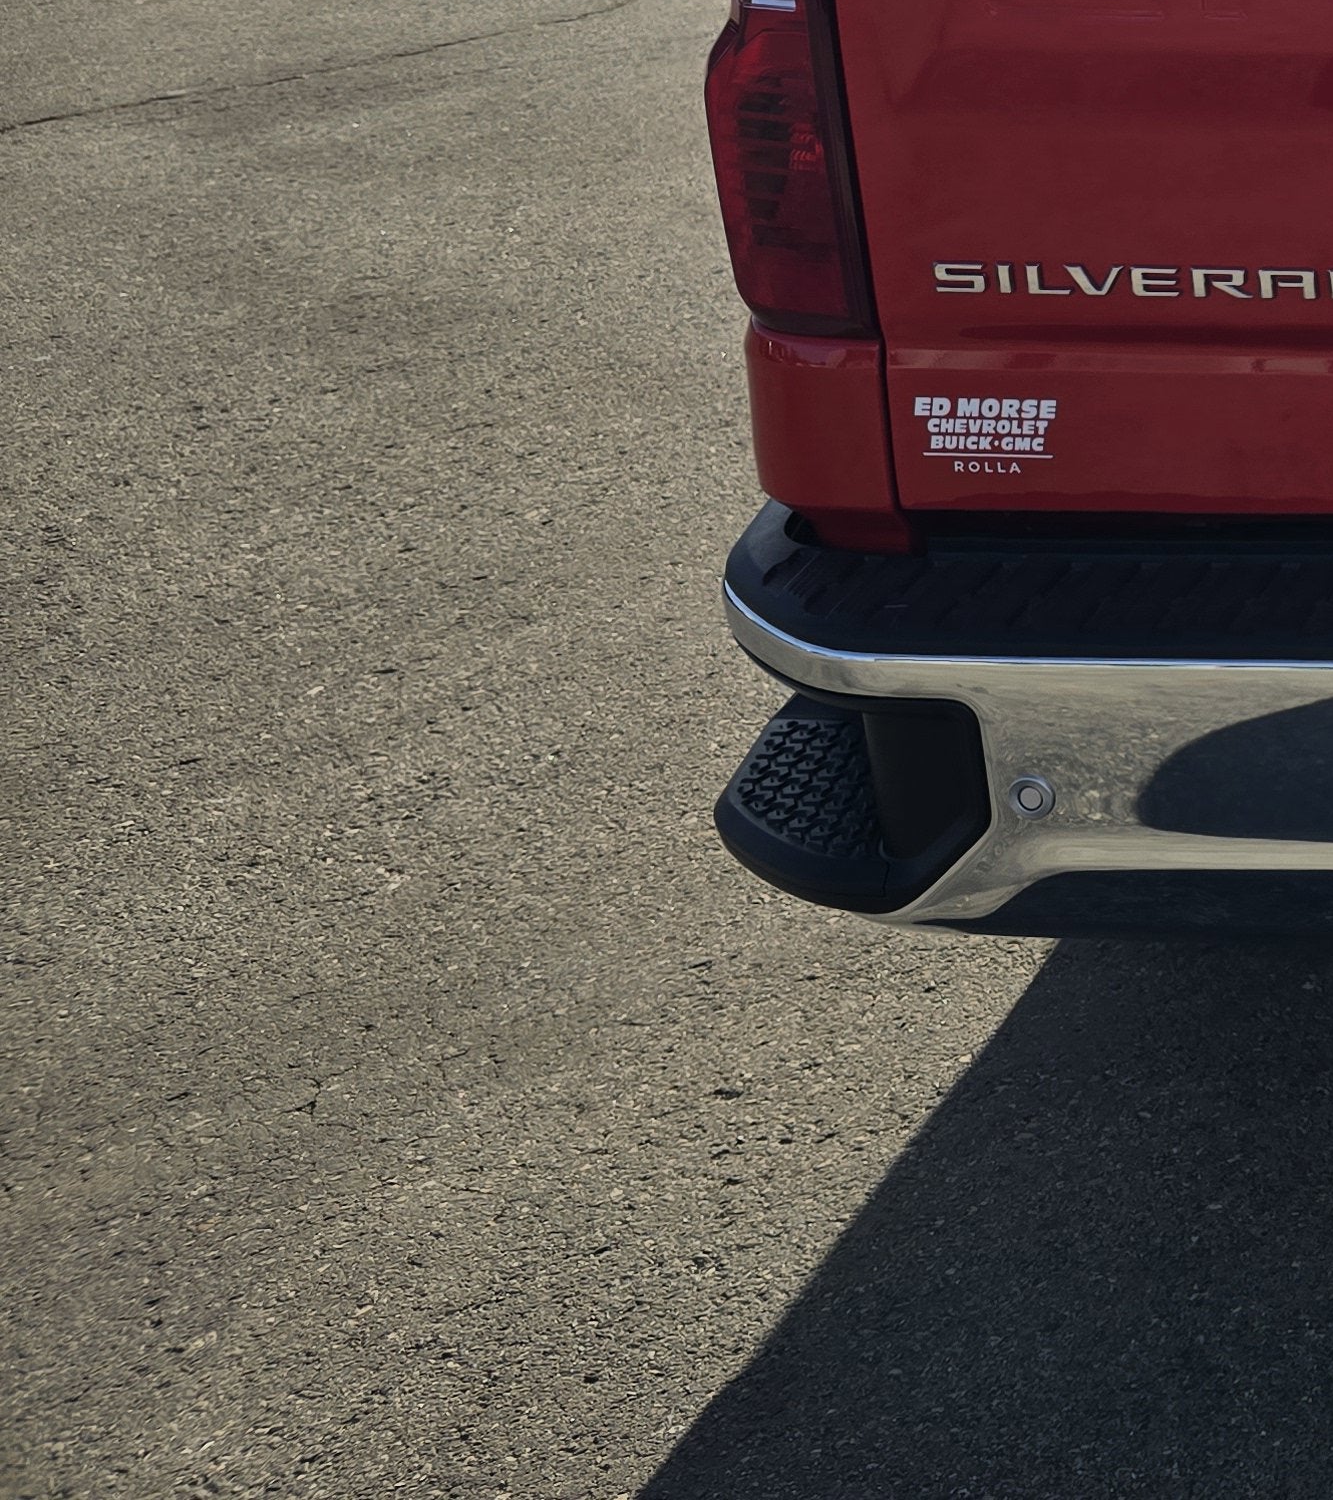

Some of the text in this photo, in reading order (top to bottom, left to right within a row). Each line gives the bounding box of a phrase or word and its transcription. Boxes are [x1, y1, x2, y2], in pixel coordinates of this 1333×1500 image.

[914, 396, 1057, 420] ED MORSE
[927, 418, 1049, 436] CHEVROLET
[954, 460, 1021, 474] ROLLA
